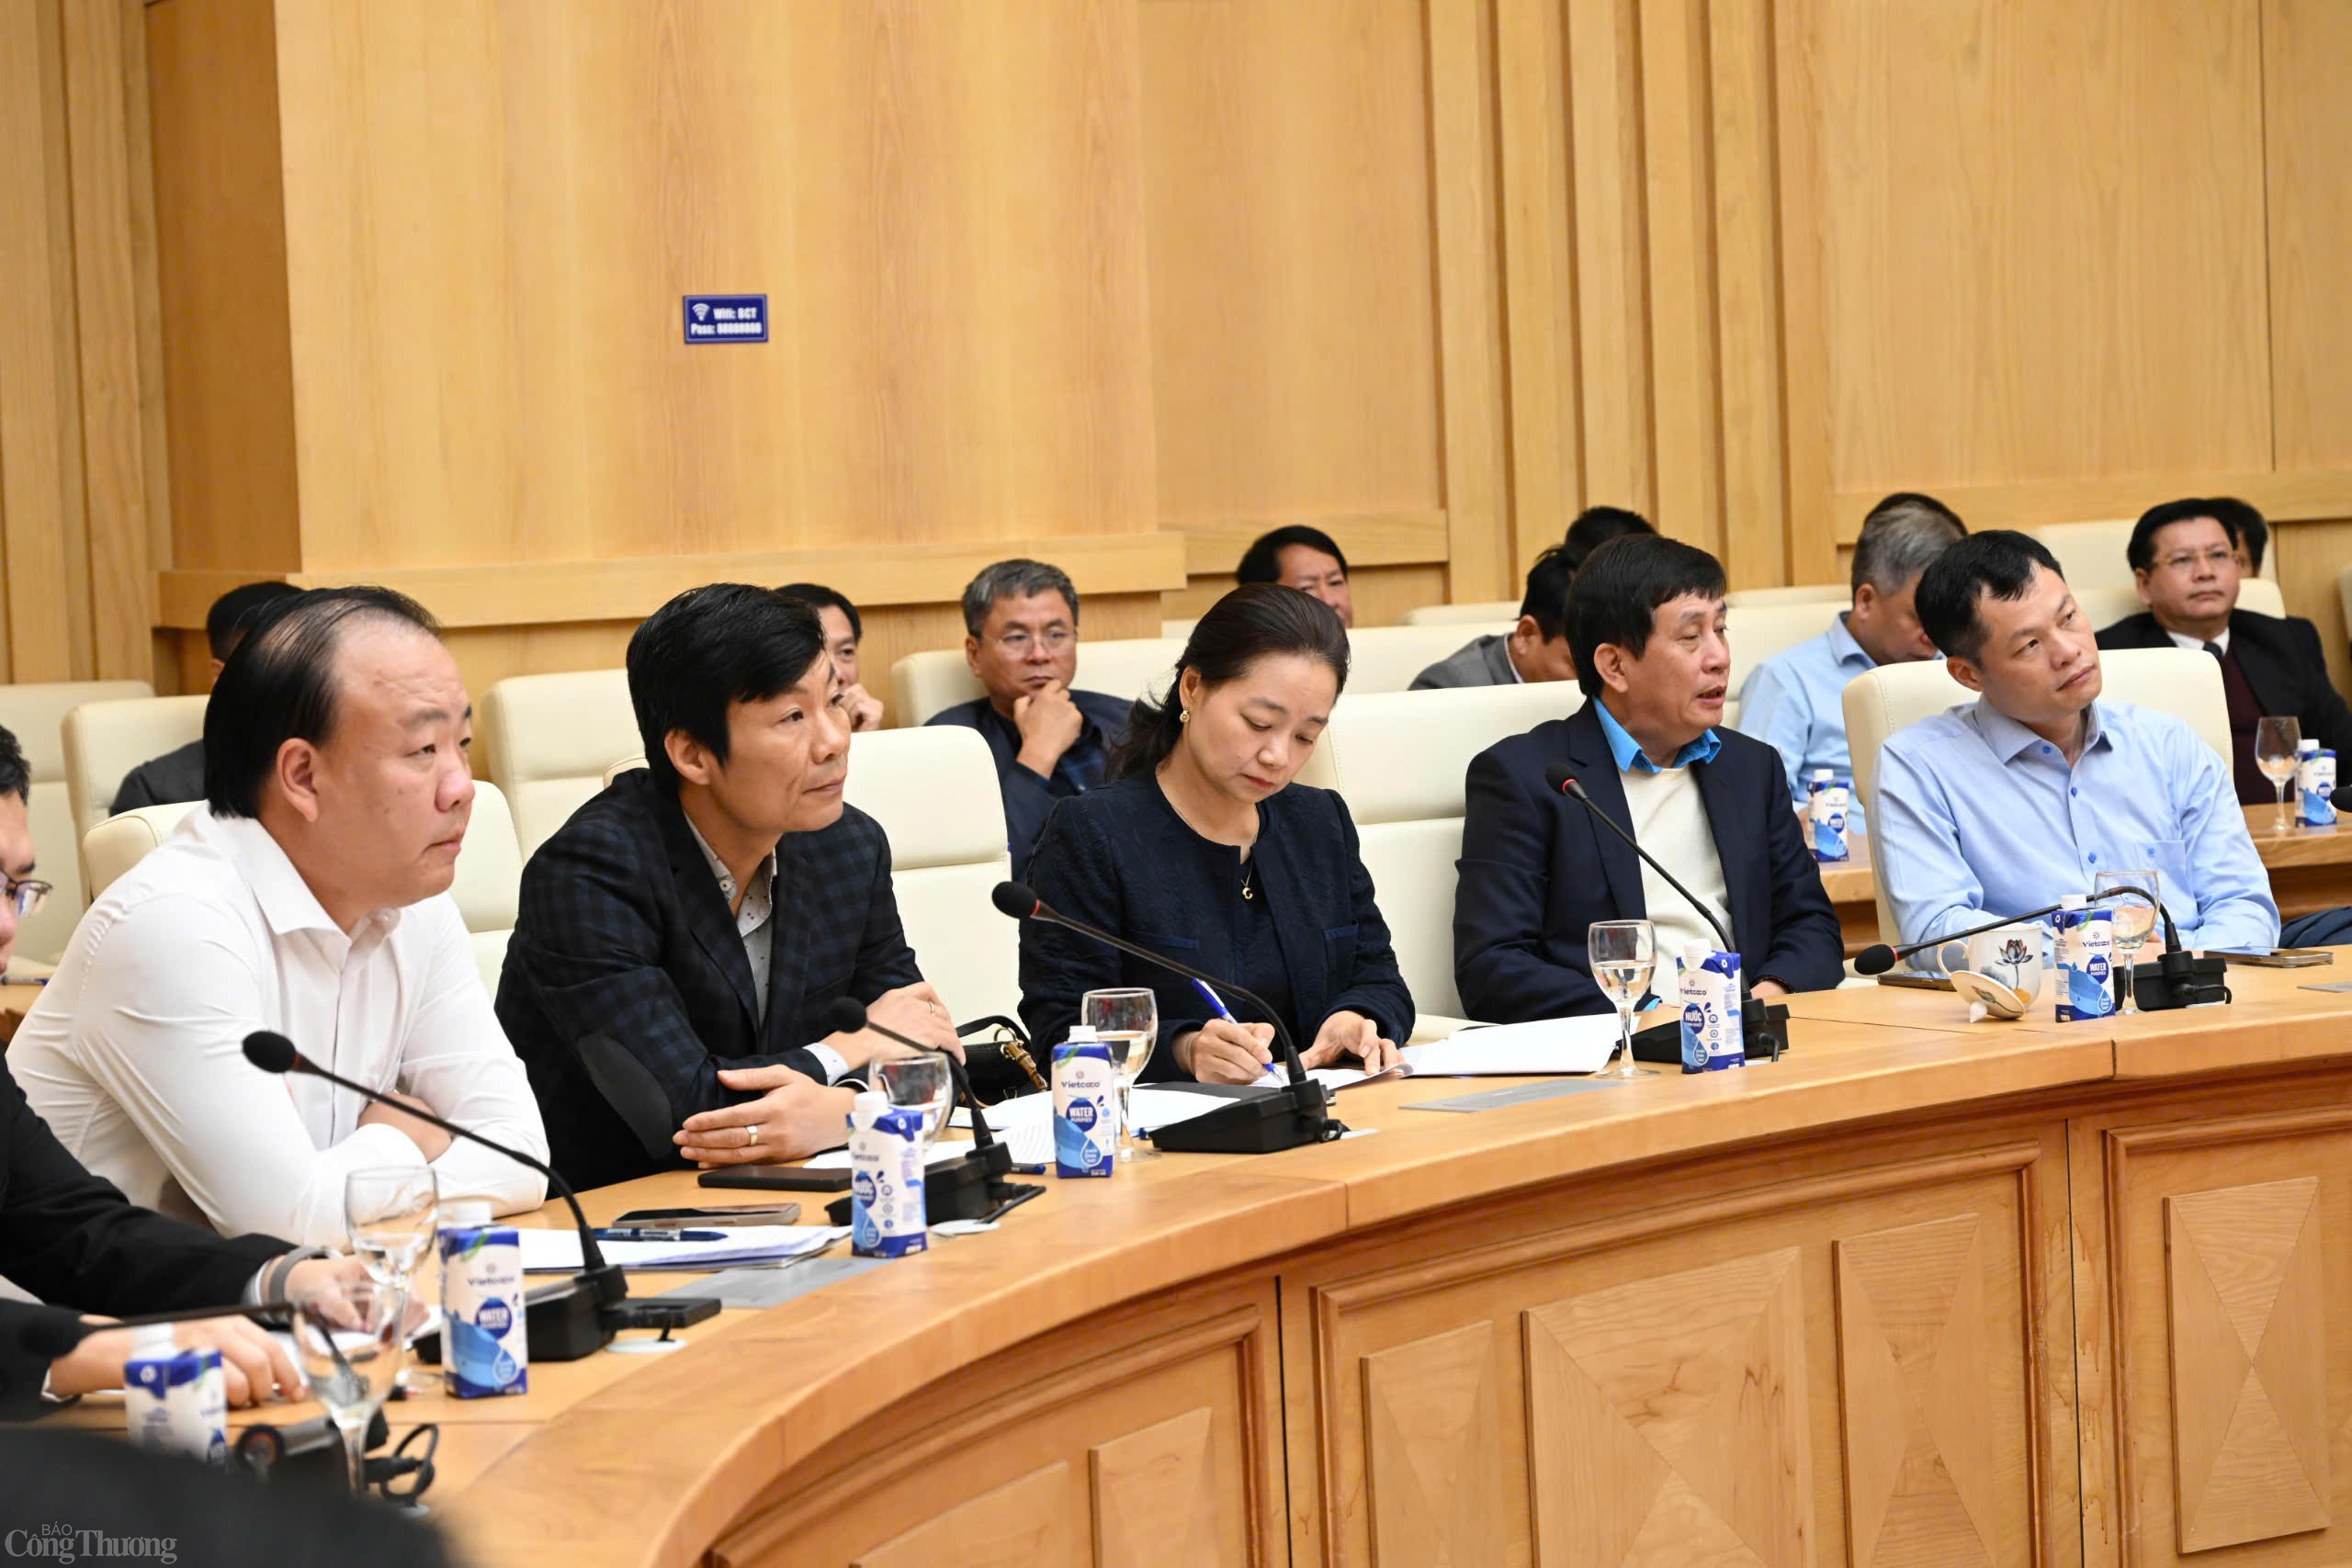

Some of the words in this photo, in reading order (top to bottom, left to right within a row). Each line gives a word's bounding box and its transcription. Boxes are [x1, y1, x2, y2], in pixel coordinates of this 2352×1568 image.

[2089, 963, 2106, 971] WATER
[1061, 1080, 1101, 1089] Vietcoco
[1069, 1107, 1093, 1117] WATER
